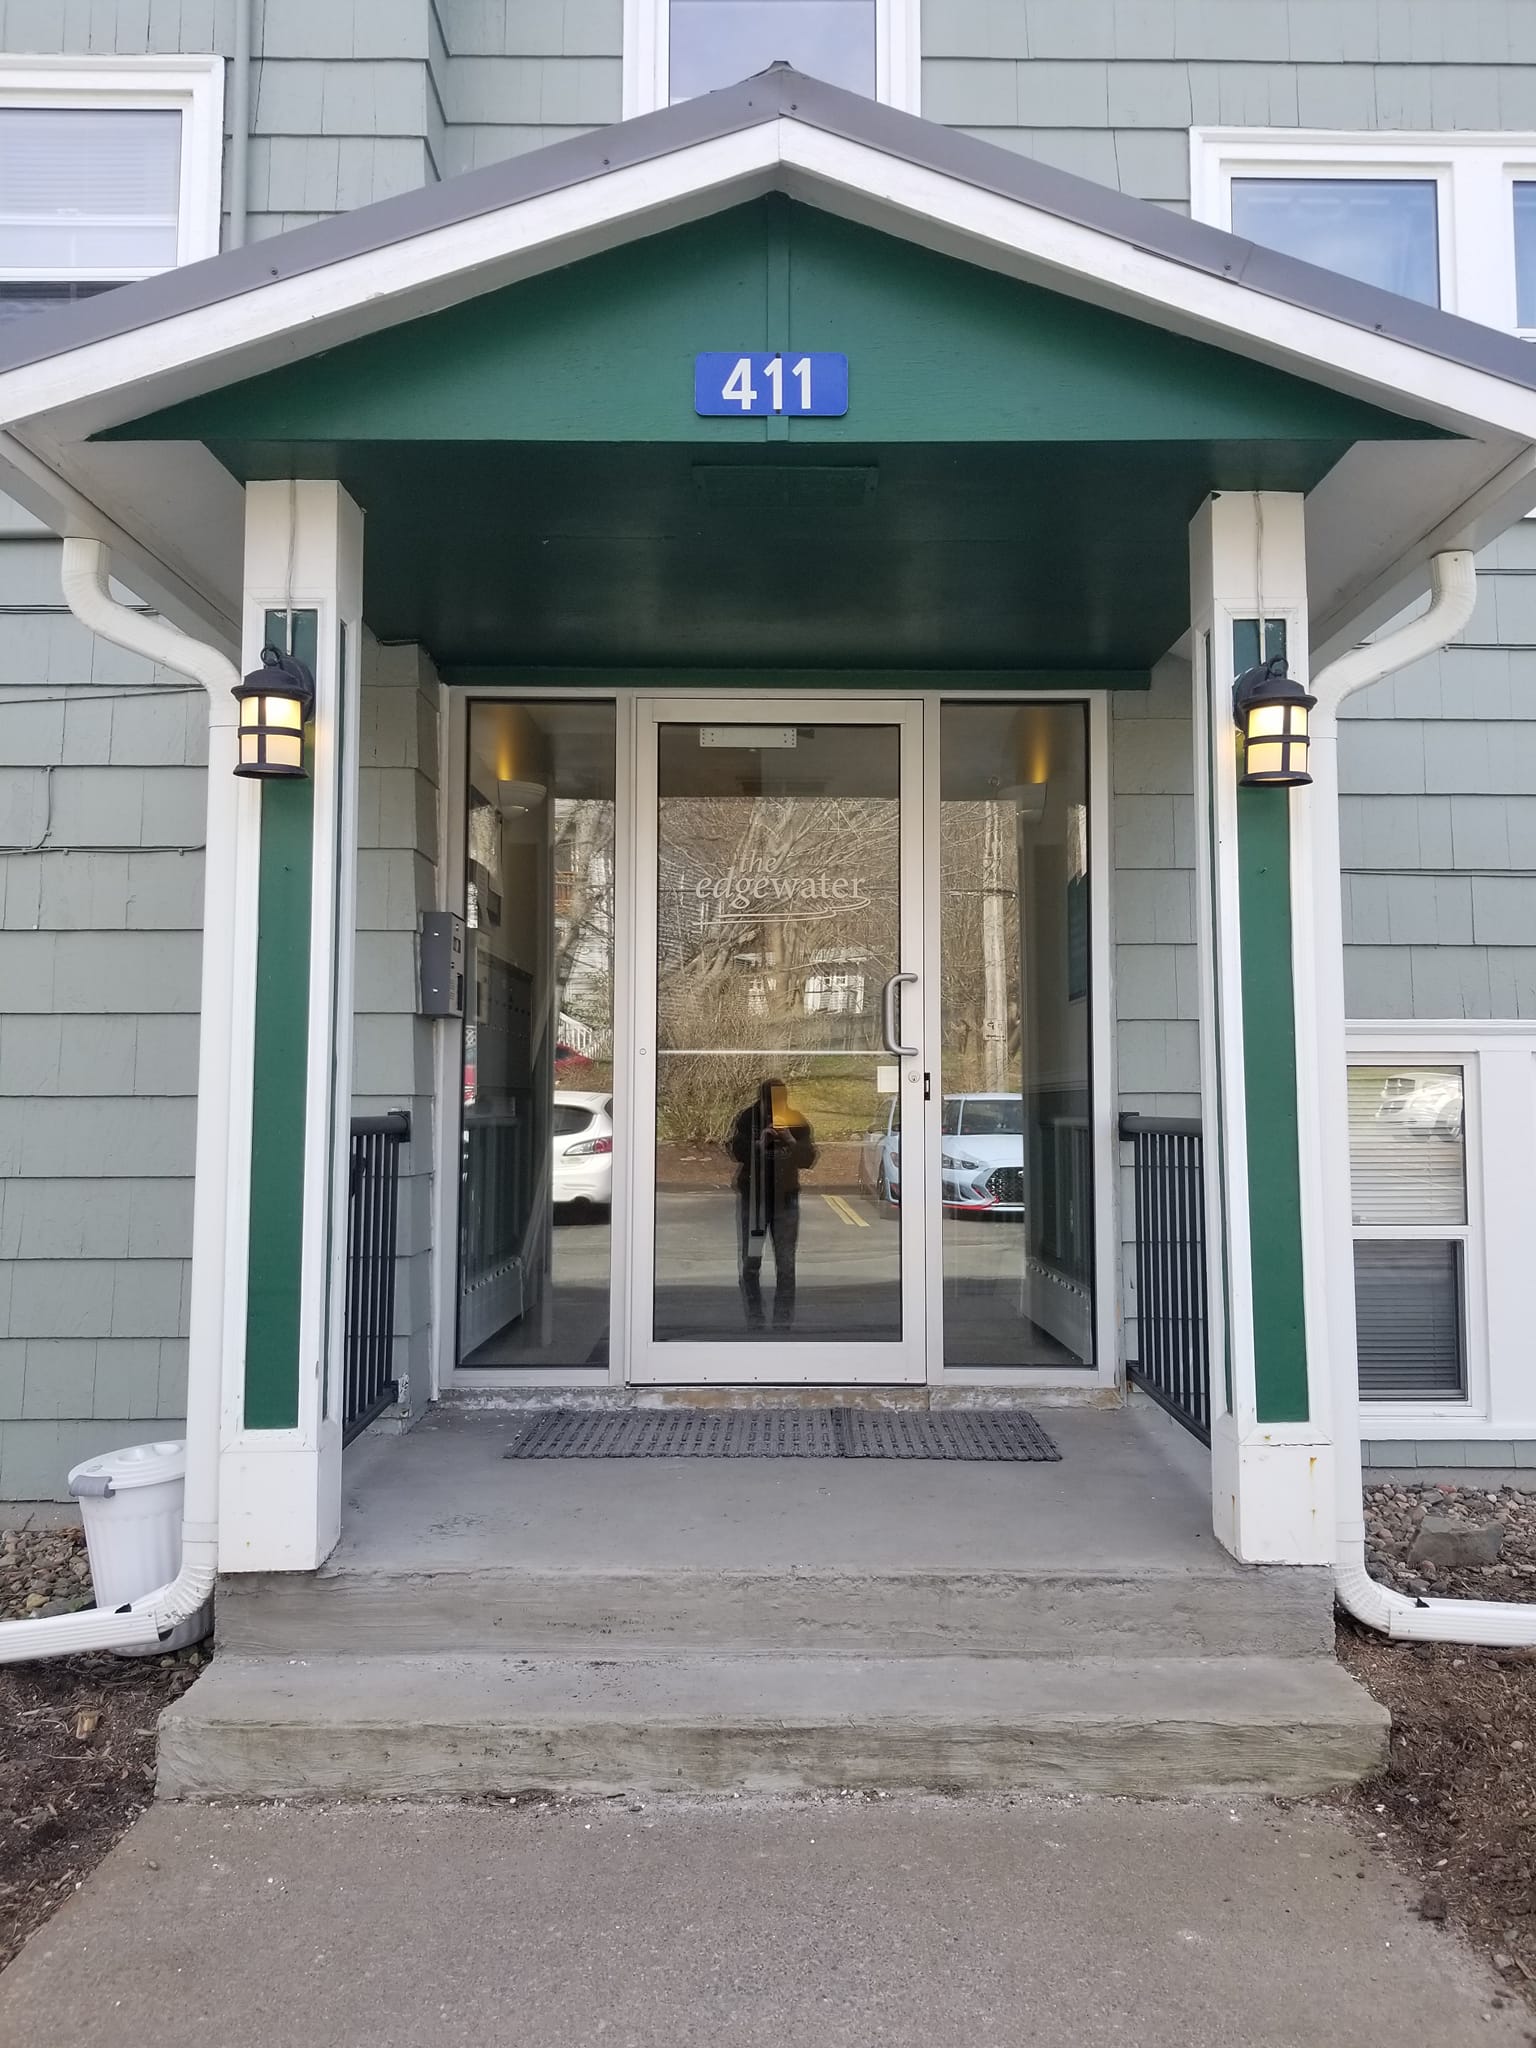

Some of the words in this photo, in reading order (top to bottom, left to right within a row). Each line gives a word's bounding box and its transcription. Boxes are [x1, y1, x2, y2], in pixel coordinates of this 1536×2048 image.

[721, 357, 812, 410] 411
[739, 850, 777, 873] the
[695, 867, 865, 909] edgewater
